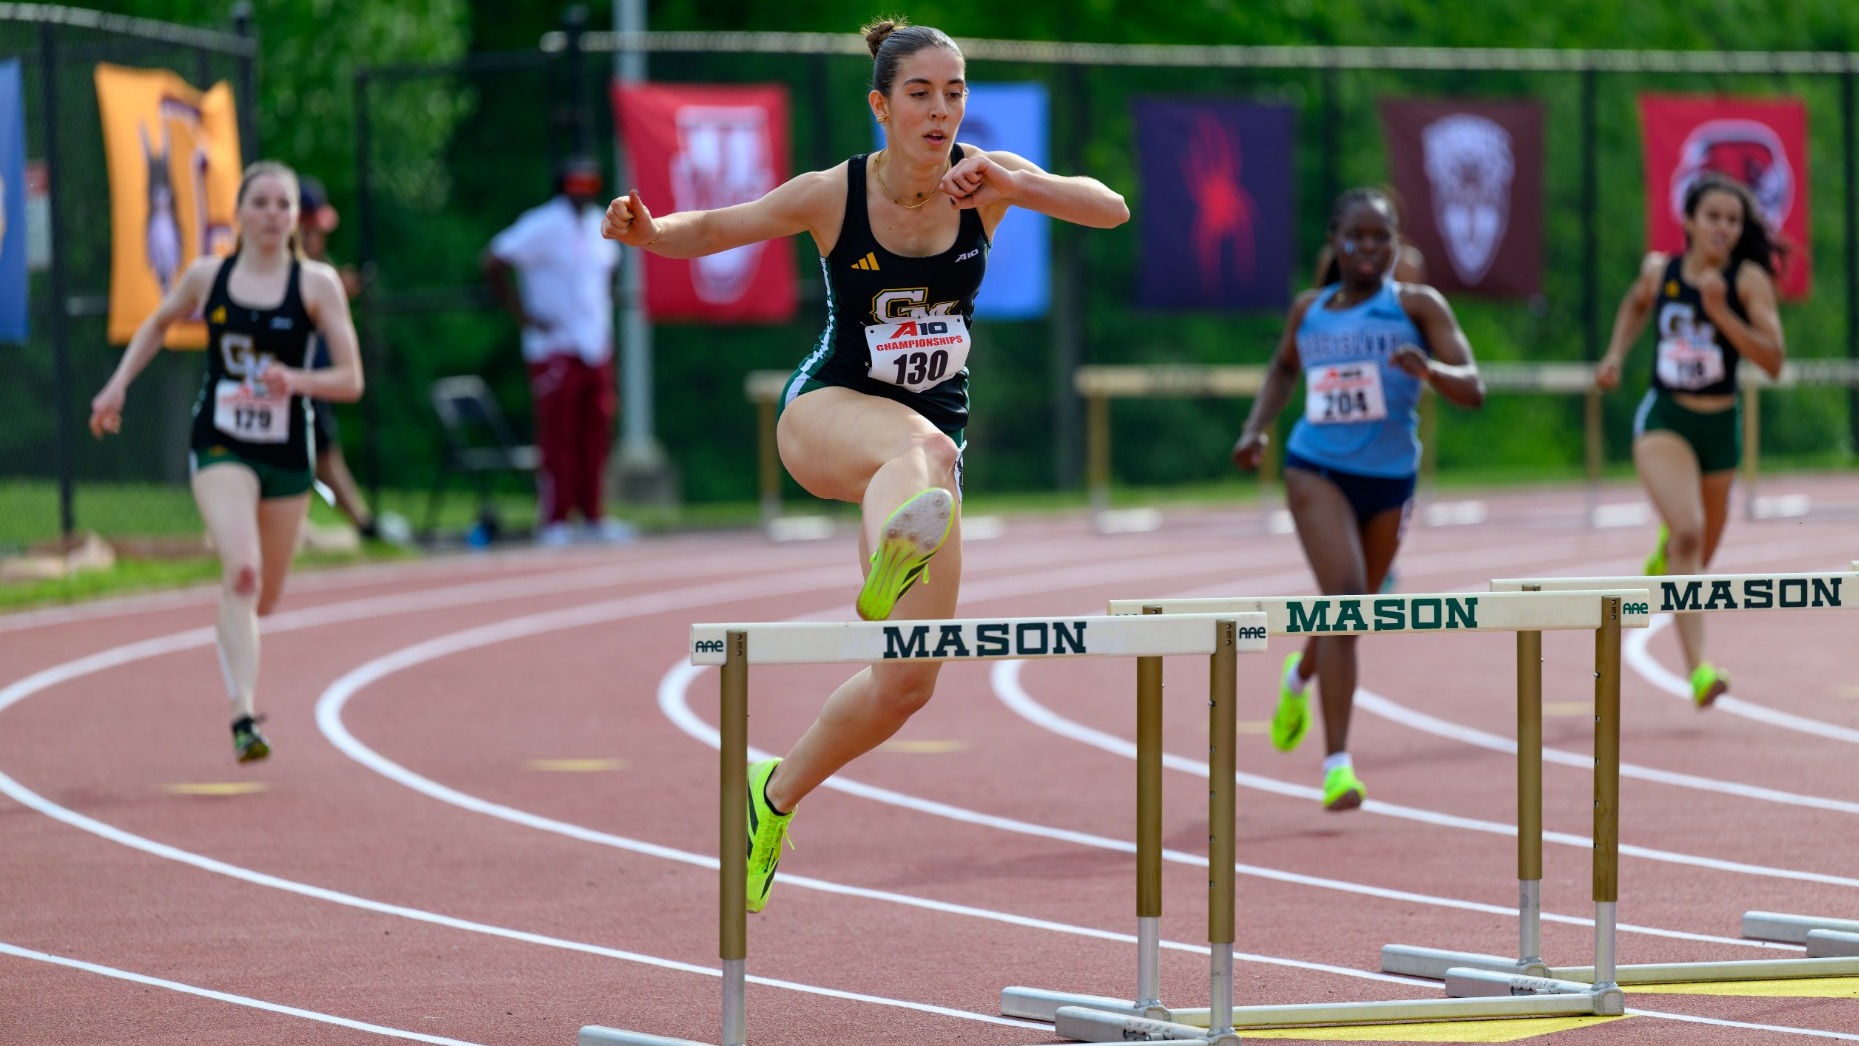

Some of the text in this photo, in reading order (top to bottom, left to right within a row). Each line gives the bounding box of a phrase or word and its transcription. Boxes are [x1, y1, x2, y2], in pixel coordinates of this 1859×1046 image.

[955, 249, 979, 263] A10
[876, 335, 963, 351] CHAMPIONSHIPS
[889, 320, 948, 340] A10
[893, 350, 948, 385] 130
[1323, 391, 1368, 418] 204
[234, 407, 272, 431] 129
[1660, 577, 1842, 611] MASON
[1286, 597, 1478, 633] MASON
[883, 621, 1087, 659] MASON
